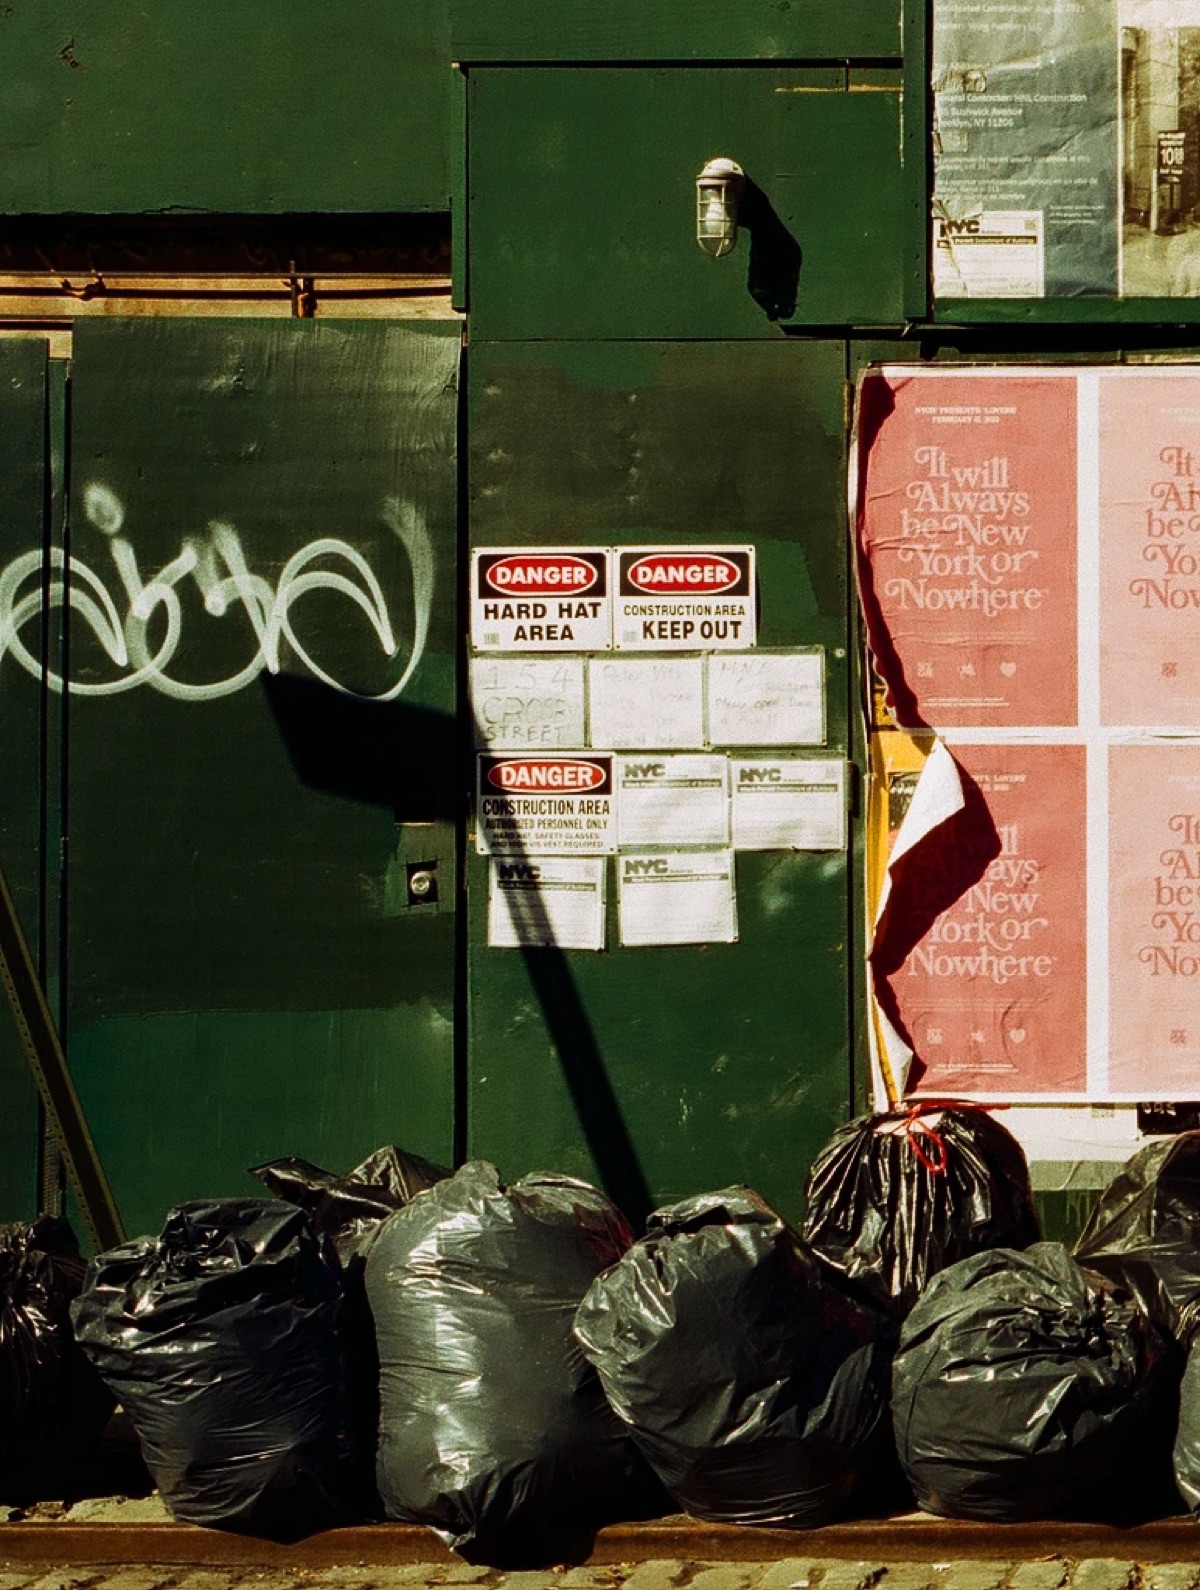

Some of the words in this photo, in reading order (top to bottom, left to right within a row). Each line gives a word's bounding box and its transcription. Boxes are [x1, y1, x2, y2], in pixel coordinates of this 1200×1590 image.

[940, 219, 980, 237] NYC
[915, 446, 948, 477] It
[948, 458, 1010, 488] will
[1159, 446, 1194, 477] It
[906, 482, 1030, 520] Always
[902, 511, 939, 538] be
[943, 514, 1030, 546] New
[1146, 512, 1184, 538] be
[898, 545, 1003, 583] York
[991, 551, 1039, 573] or
[496, 566, 587, 585] DANGER
[637, 565, 730, 584] DANGER
[885, 579, 1043, 616] Nowhere
[484, 603, 547, 620] HARD
[558, 602, 601, 619] HAT
[624, 605, 712, 616] CONSTRUCTION
[715, 605, 745, 616] AREA
[514, 625, 574, 641] AREA
[643, 621, 694, 639] KEEP
[700, 620, 742, 638] OUT
[485, 725, 567, 742] STREET
[502, 766, 593, 786] DANGER
[624, 763, 666, 778] NYC
[739, 767, 782, 782] NYC
[483, 800, 574, 815] CONSTRUCTION
[578, 800, 610, 815] AREA
[486, 818, 535, 829] AUTHORIZED
[538, 818, 583, 829] PERSONNEL
[587, 818, 608, 829] ONLY
[498, 864, 541, 880] NYC
[625, 858, 668, 874] NYC
[956, 882, 1040, 914] New
[1155, 878, 1193, 907] be
[1000, 920, 1048, 942] or
[903, 947, 1052, 984] Nowhere
